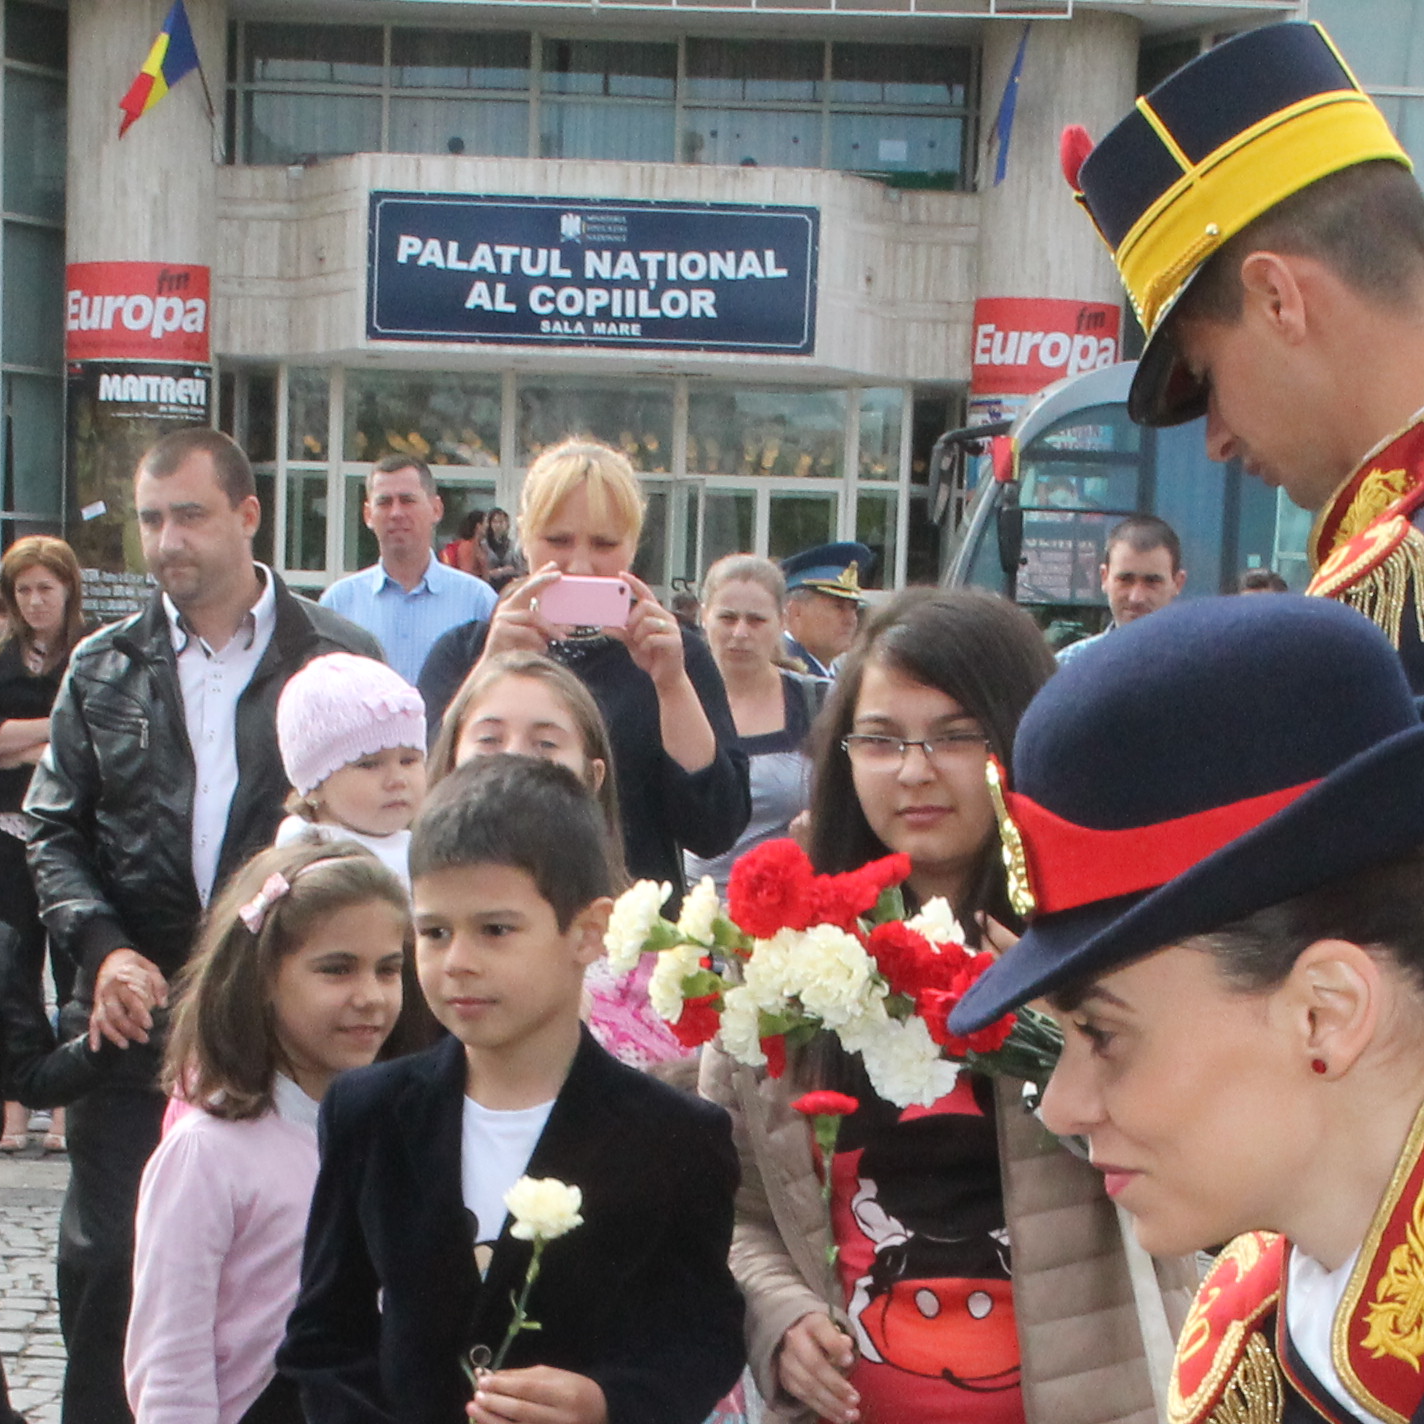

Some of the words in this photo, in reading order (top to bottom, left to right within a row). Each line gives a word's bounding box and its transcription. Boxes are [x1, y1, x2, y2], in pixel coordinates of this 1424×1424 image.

[397, 235, 572, 277] PALATUL
[584, 250, 788, 290] NAȚIONAL
[157, 269, 189, 294] fm
[465, 281, 516, 313] AL
[529, 286, 717, 318] COPIILOR
[67, 290, 206, 339] Europa
[540, 320, 585, 334] SALA
[593, 322, 642, 336] MARE
[1078, 307, 1105, 331] fm
[974, 324, 1116, 377] Europa
